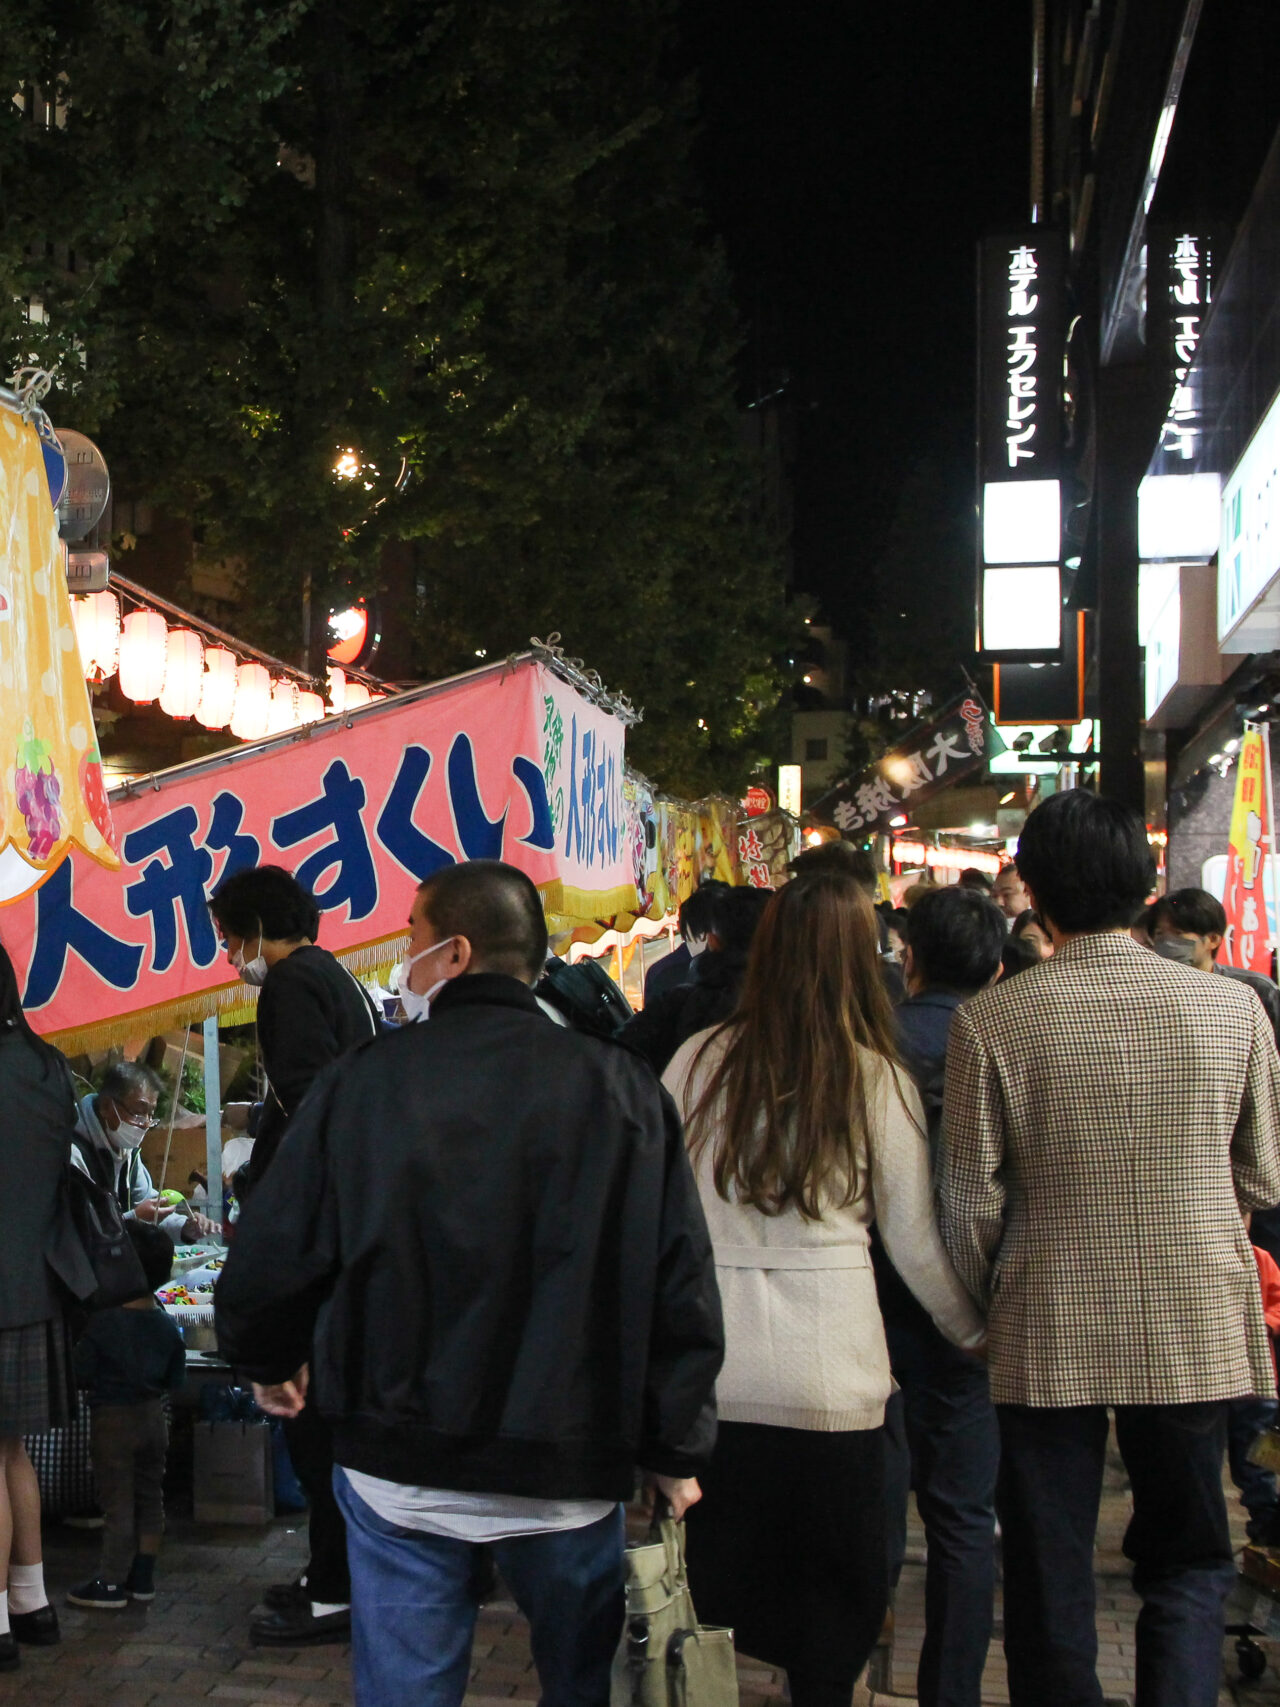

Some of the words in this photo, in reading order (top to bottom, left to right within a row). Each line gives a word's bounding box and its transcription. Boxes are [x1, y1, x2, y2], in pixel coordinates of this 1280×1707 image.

[1007, 245, 1038, 317] ホテル
[1006, 326, 1037, 468] エクセレント
[21, 731, 555, 1010] 人形すくい
